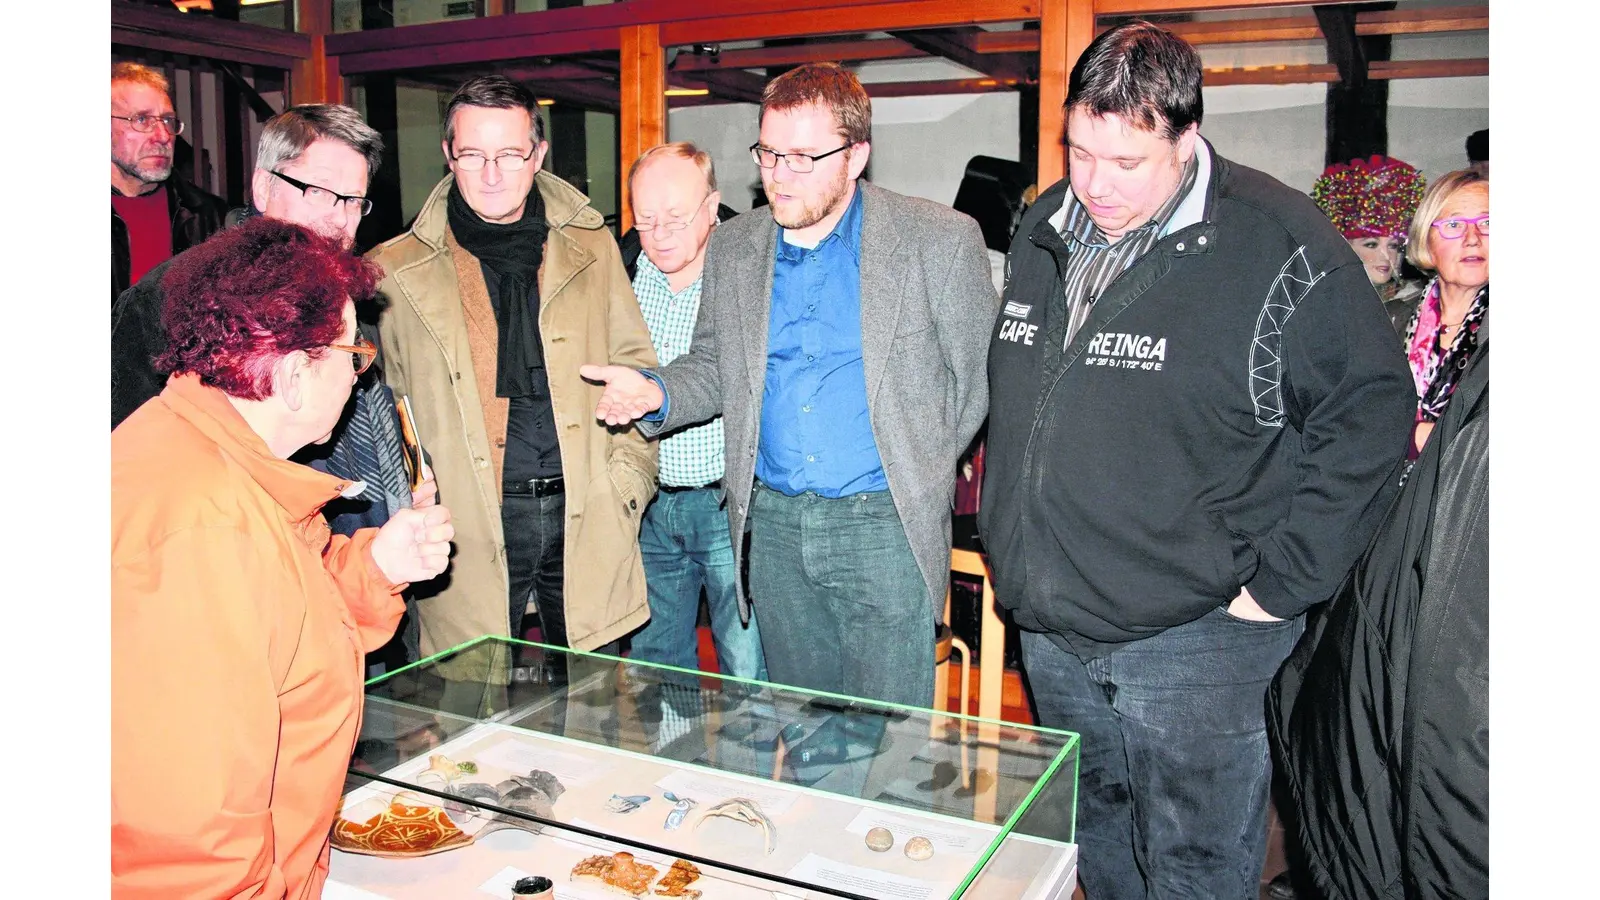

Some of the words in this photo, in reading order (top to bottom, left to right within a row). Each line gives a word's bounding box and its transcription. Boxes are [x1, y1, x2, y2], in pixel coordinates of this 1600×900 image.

[999, 319, 1038, 346] CAPE
[1088, 333, 1166, 361] REINGA
[1109, 358, 1115, 367] S
[1154, 362, 1162, 371] E
